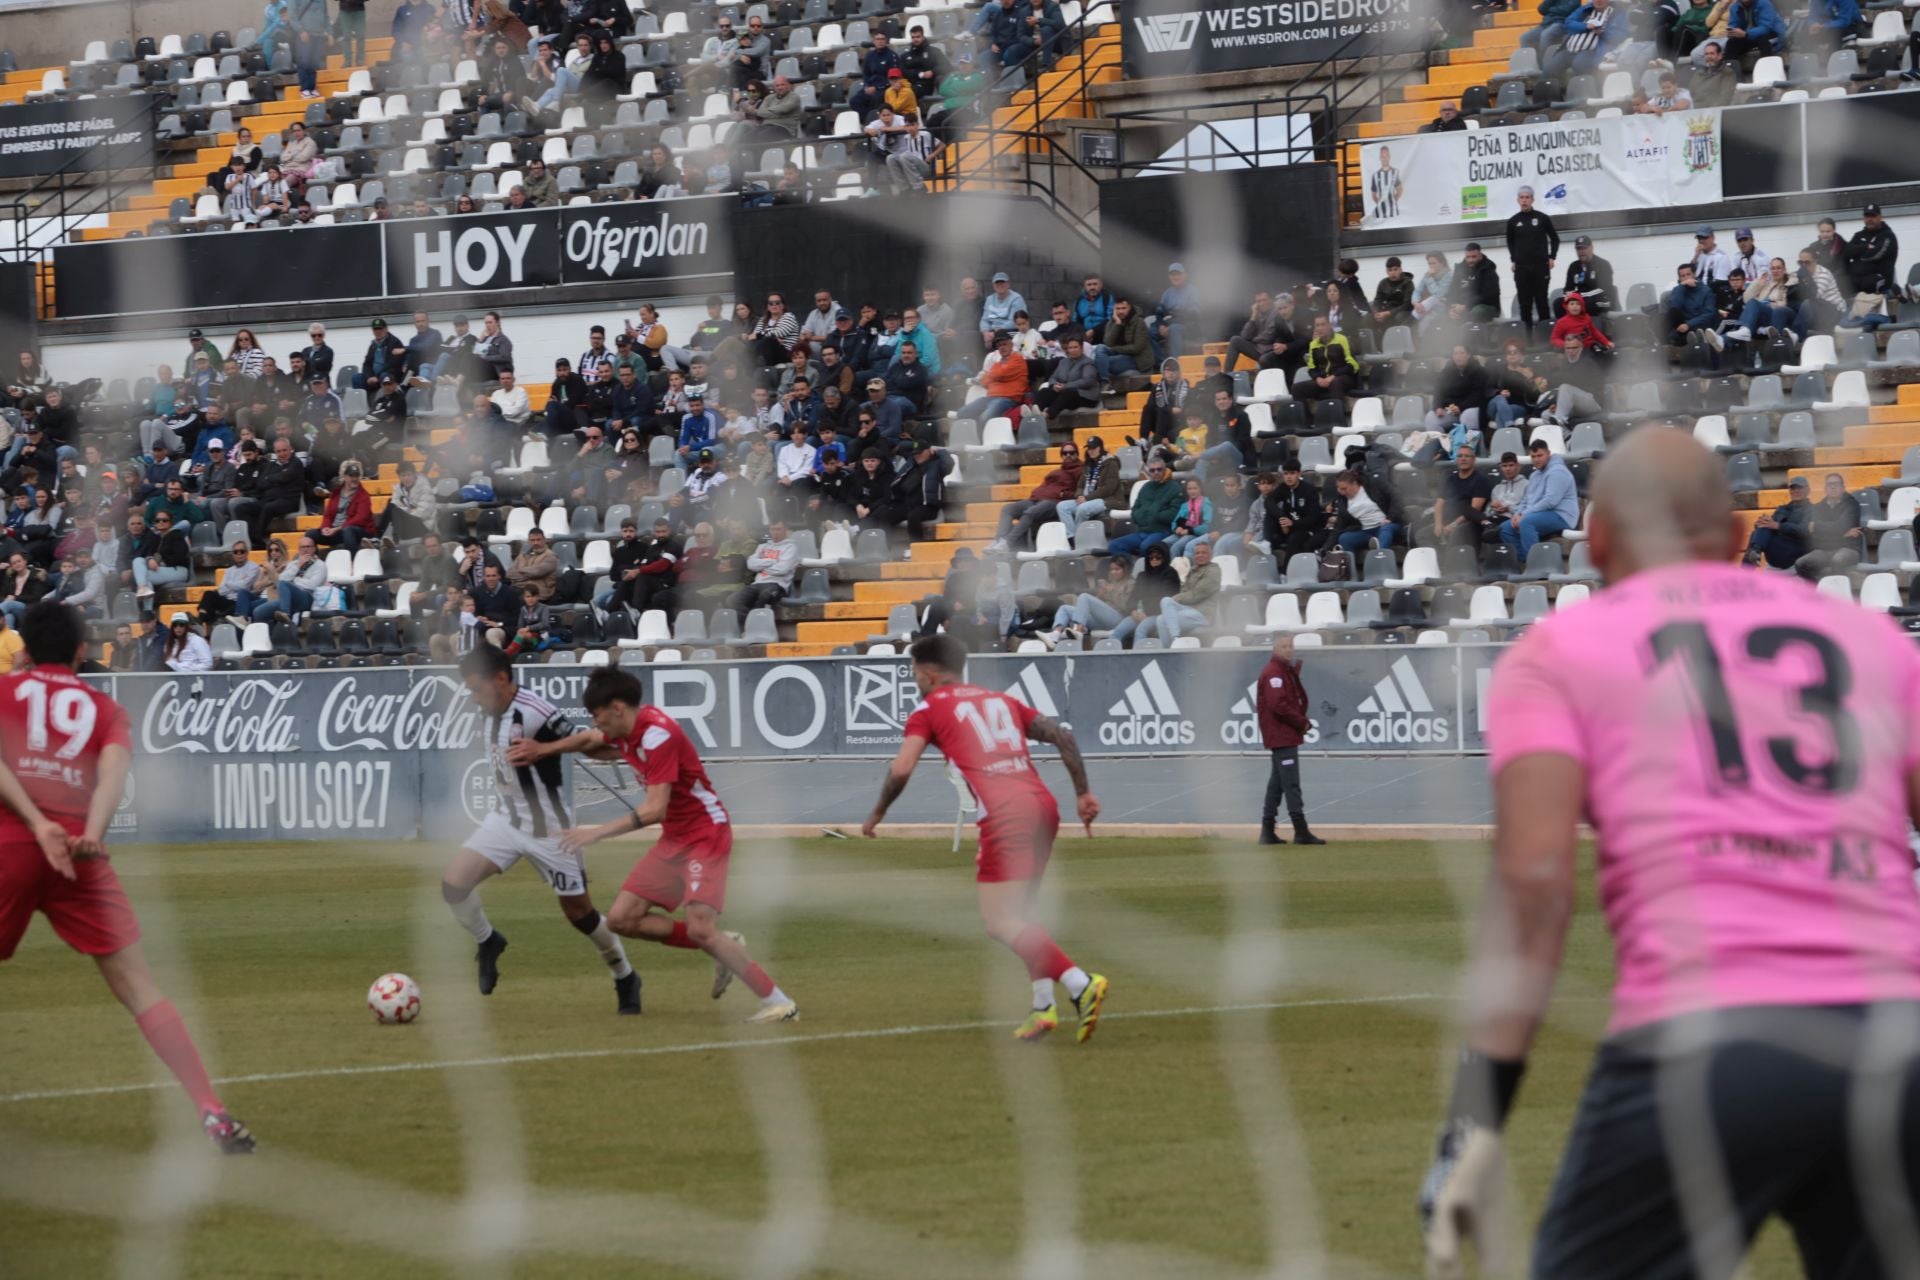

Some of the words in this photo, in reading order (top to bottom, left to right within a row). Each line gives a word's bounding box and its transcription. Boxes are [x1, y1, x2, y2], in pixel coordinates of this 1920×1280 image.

[1206, 0, 1410, 32] WESTSIDEDRON
[1211, 27, 1329, 49] WWW.WSDRON.COM
[0, 127, 18, 138] TUS
[18, 123, 66, 137] EVENTOS
[66, 122, 82, 133] DE
[1508, 128, 1602, 153] BLANQUINEGRA
[2, 141, 56, 154] EMPRESAS
[55, 139, 64, 149] Y
[1626, 146, 1669, 158] ALTAFIT
[1469, 157, 1523, 182] GUZMÁN
[1537, 152, 1603, 176] CASASECA
[413, 223, 537, 289] HOY
[566, 212, 709, 271] Oferplan
[14, 679, 97, 760] 19
[142, 680, 303, 753] Coca-Cola
[317, 676, 480, 750] Coca-Cola
[653, 664, 827, 749] RIO
[1645, 618, 1863, 798] 13
[846, 734, 904, 745] Restauració
[953, 697, 1022, 752] 14
[1100, 715, 1196, 746] adidas
[1221, 716, 1320, 745] ads
[1347, 712, 1449, 745] adidas
[213, 761, 391, 830] IMPULSO27
